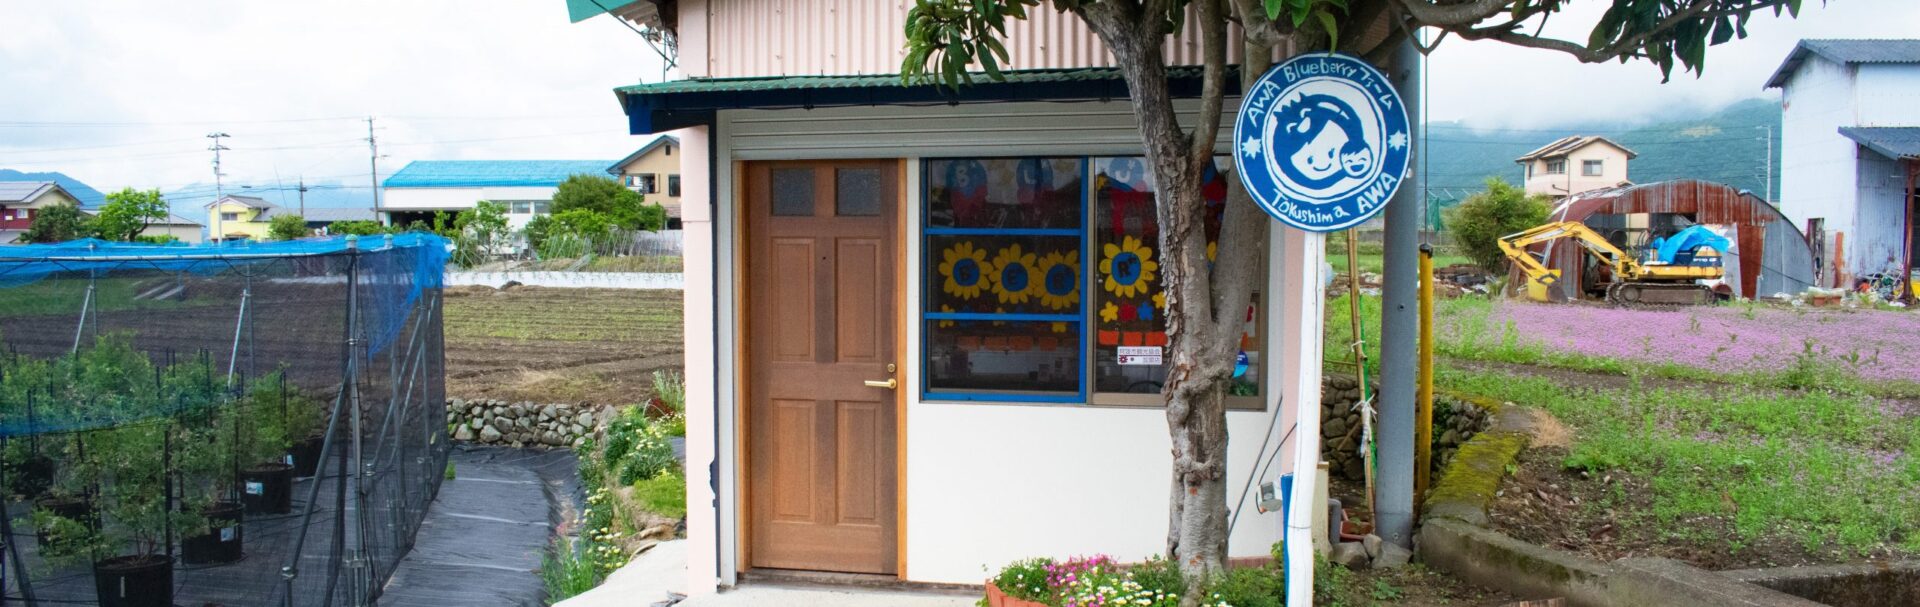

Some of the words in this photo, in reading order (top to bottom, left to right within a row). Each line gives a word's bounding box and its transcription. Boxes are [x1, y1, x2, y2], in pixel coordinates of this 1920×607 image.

[1247, 80, 1281, 127] AWA
[1283, 58, 1357, 82] Blueberry
[1360, 66, 1393, 110] ファーム
[1271, 188, 1351, 224] Tokushima
[1356, 171, 1398, 214] AWA
